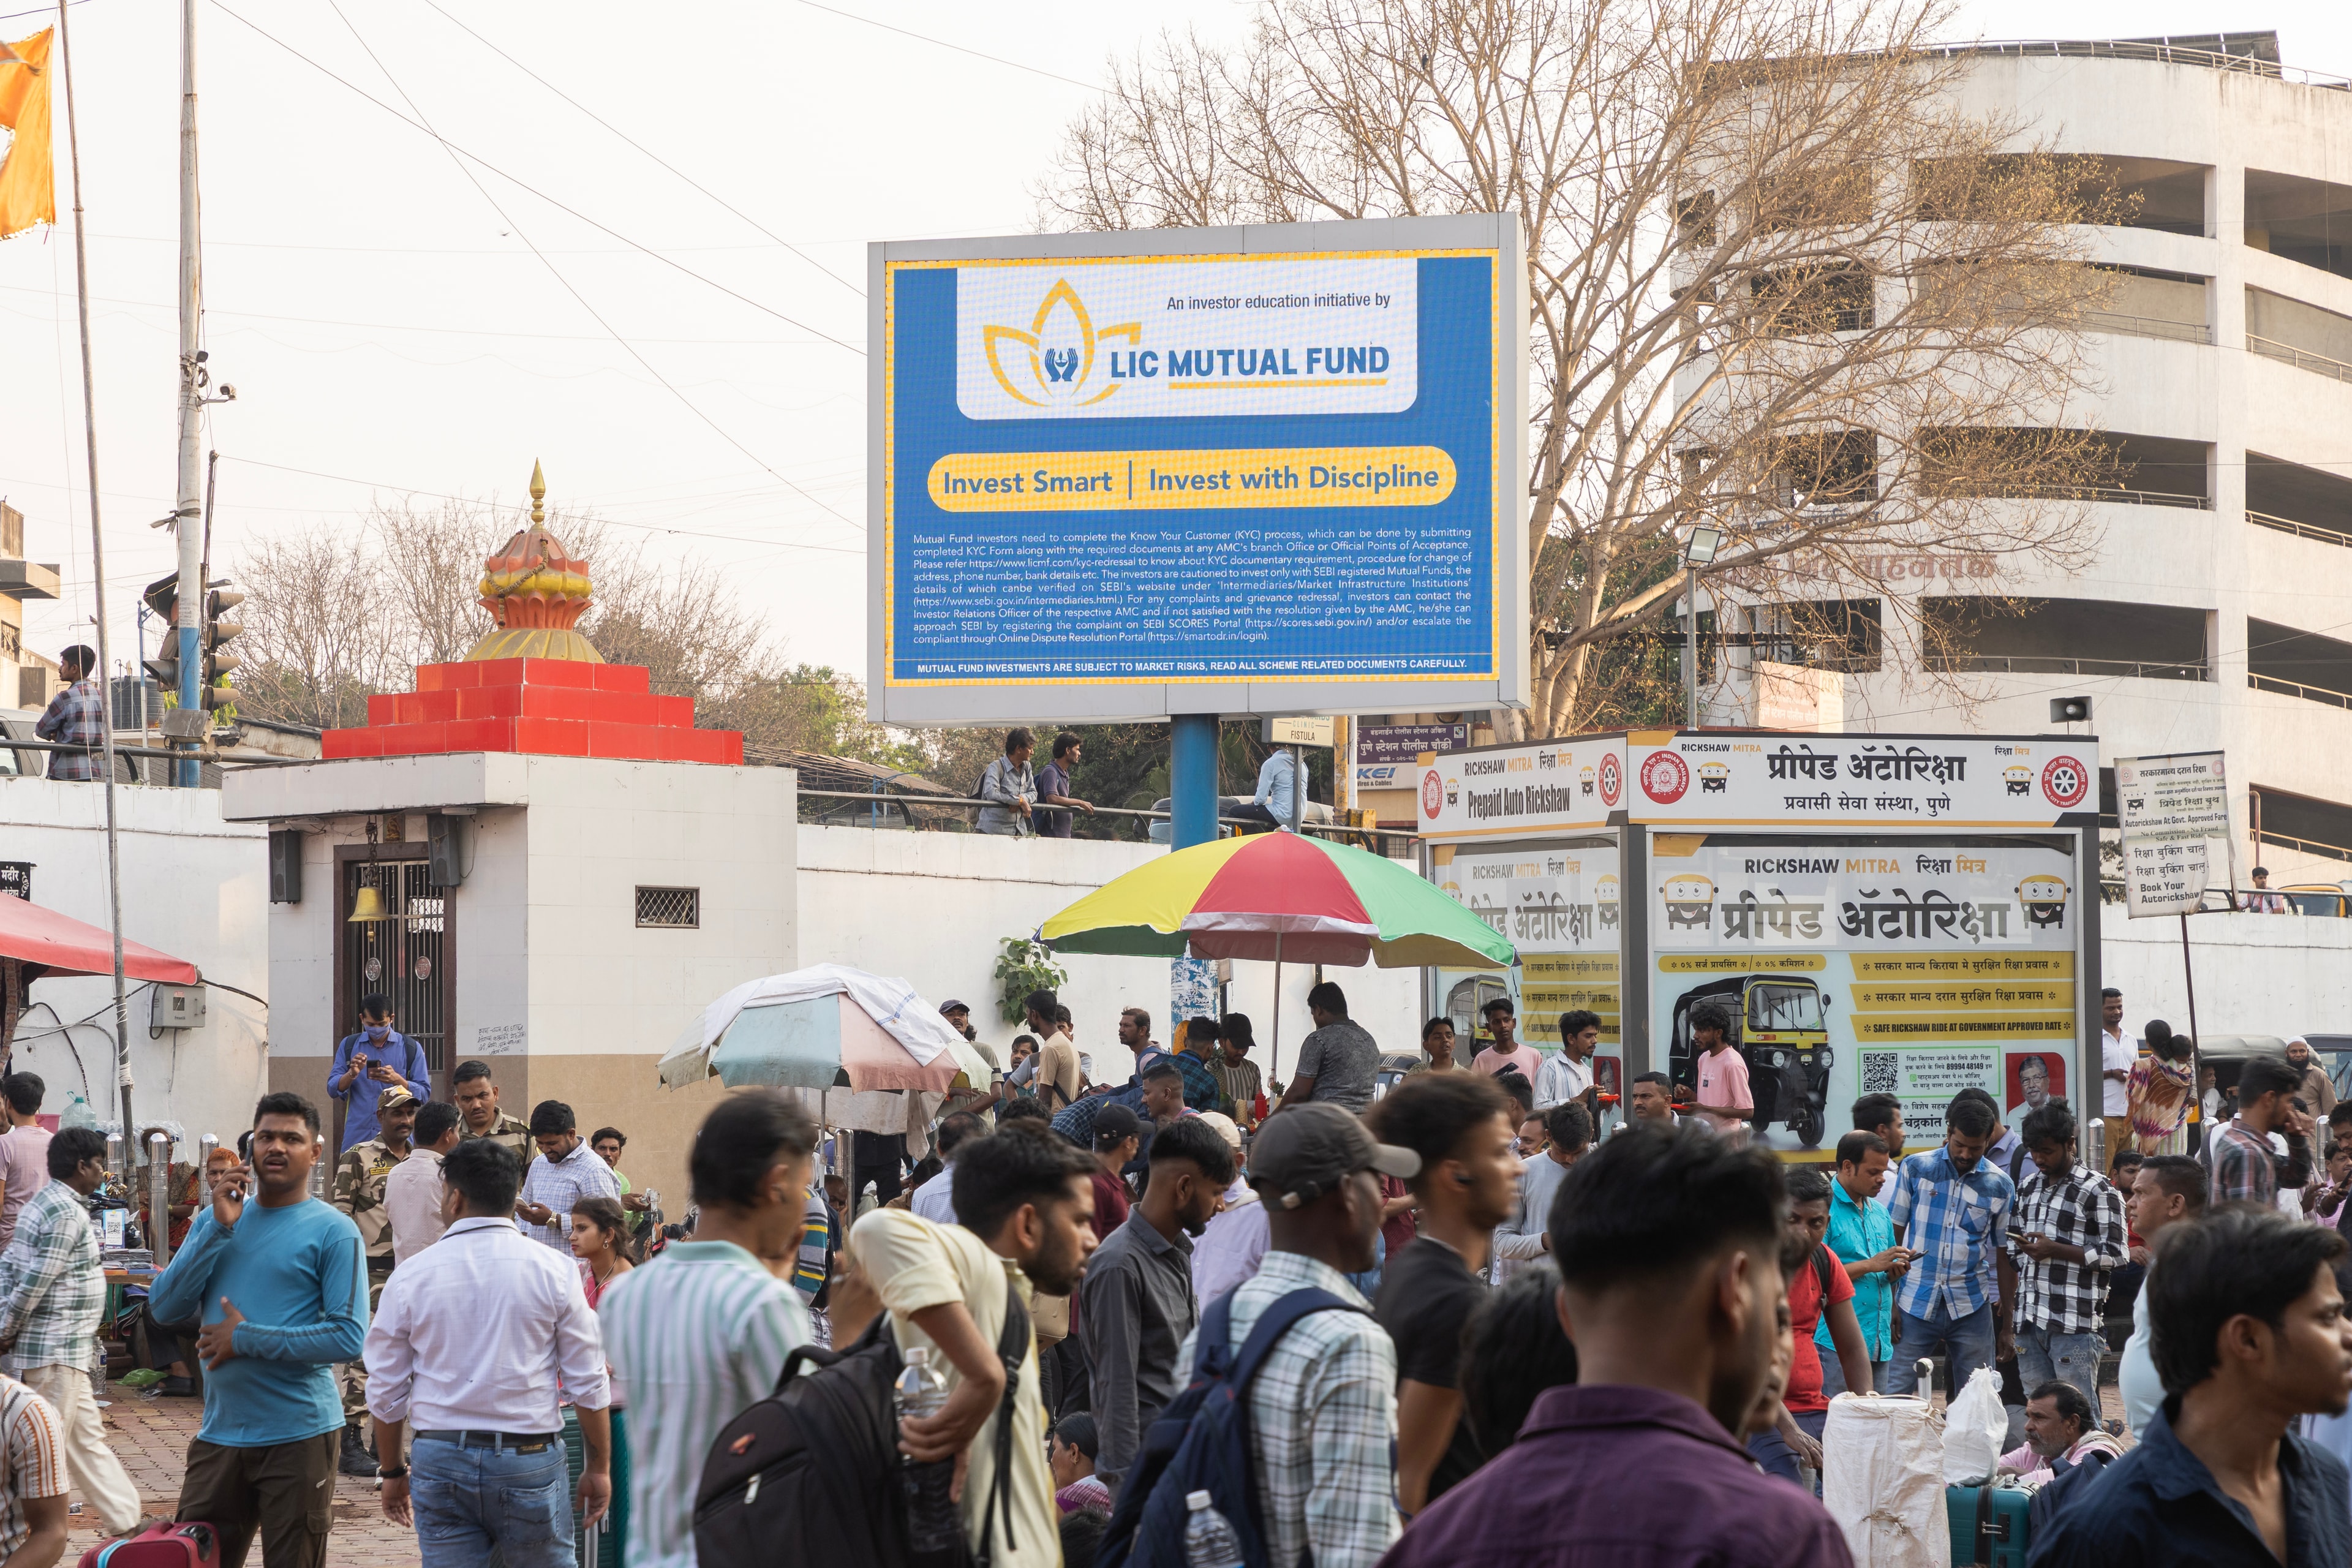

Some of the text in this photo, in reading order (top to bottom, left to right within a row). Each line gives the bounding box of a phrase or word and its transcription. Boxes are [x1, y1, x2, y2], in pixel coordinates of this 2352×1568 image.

[1167, 293, 1390, 309] An investor education initiative by
[1112, 347, 1389, 377] LIC MUTUAL FUND
[944, 464, 1439, 493] Invest Smart Invest with Discipline
[914, 534, 944, 543] Mutual
[950, 534, 972, 543] Fund
[1022, 533, 1045, 541] need
[1063, 532, 1107, 544] complete
[1111, 532, 1126, 541] the
[1131, 532, 1156, 540] Know
[1186, 531, 1231, 540] Customer
[1235, 530, 1260, 540] (KYC)
[1265, 532, 1303, 541] process,
[1308, 529, 1334, 538] which
[1360, 529, 1371, 537] be
[1376, 529, 1400, 537] done
[1406, 528, 1416, 539] by
[1421, 527, 1471, 538] submitting
[914, 560, 943, 568] Please
[946, 559, 967, 568] refer
[970, 557, 1136, 570] https://www.licmf.com/kyc-redressal
[1151, 556, 1175, 565] know
[1178, 556, 1205, 565] about
[1208, 556, 1227, 564] KYC
[1231, 556, 1292, 566] documentary
[1295, 555, 1354, 566] requirement,
[1358, 554, 1406, 565] procedure
[1409, 553, 1422, 562] for
[1425, 553, 1458, 564] change
[1462, 552, 1472, 561] of
[1128, 595, 1143, 603] For
[1148, 597, 1164, 605] any
[1169, 594, 1219, 605] complaints
[1225, 593, 1242, 602] and
[1248, 594, 1292, 604] grievance
[1298, 592, 1342, 602] redressal,
[918, 659, 1467, 673] MUTUAL FUND INVESTMENTS ARE SUBJECT TO MARKET RISKS, READ ALL SCHEME RELATED DOCUMENTS CAREFULLY.
[1291, 731, 1315, 741] FISTULA
[1360, 737, 1452, 755] पुणे स्टेशन पोलीस चौकी
[1681, 744, 1762, 753] RICKSHAW MITRA
[1995, 745, 2030, 756] रिक्षा मित्र
[1465, 756, 1533, 776] RICKSHAW MITRA
[1539, 748, 1572, 771] रिक्षा मित्र
[1357, 767, 1396, 778] KEI
[2193, 764, 2206, 773] रिक्षा
[1468, 788, 1502, 820] Prepaid
[1504, 787, 1524, 816] Auto
[1525, 784, 1570, 814] Rickshaw
[1784, 791, 1951, 816] प्रवासी सेवा संस्था, पुणे
[2125, 818, 2162, 827] Autorickshaw
[2188, 814, 2213, 823] Approved
[1473, 862, 1541, 880] RICKSHAW MITRA
[1548, 856, 1581, 877] रिक्षा मित्र
[1746, 859, 1900, 873] RICKSHAW MITRA
[1916, 854, 1986, 875] रिक्षा मित्र
[1, 866, 19, 881] मंदीर
[2141, 883, 2161, 892] Book
[2142, 892, 2199, 903] Autorickshaw
[1721, 889, 1823, 939] प्रीपेड
[1929, 959, 1958, 970] किराया
[1962, 959, 1969, 969] मे
[1972, 959, 2000, 973] सुरक्षित
[2004, 959, 2022, 970] रिक्षा
[1873, 1022, 2062, 1033] SAFE RICKSHAW RIDE AT GOVERNMENT APPROVED RATE
[1904, 1115, 1942, 1129] चंद्रकांत
